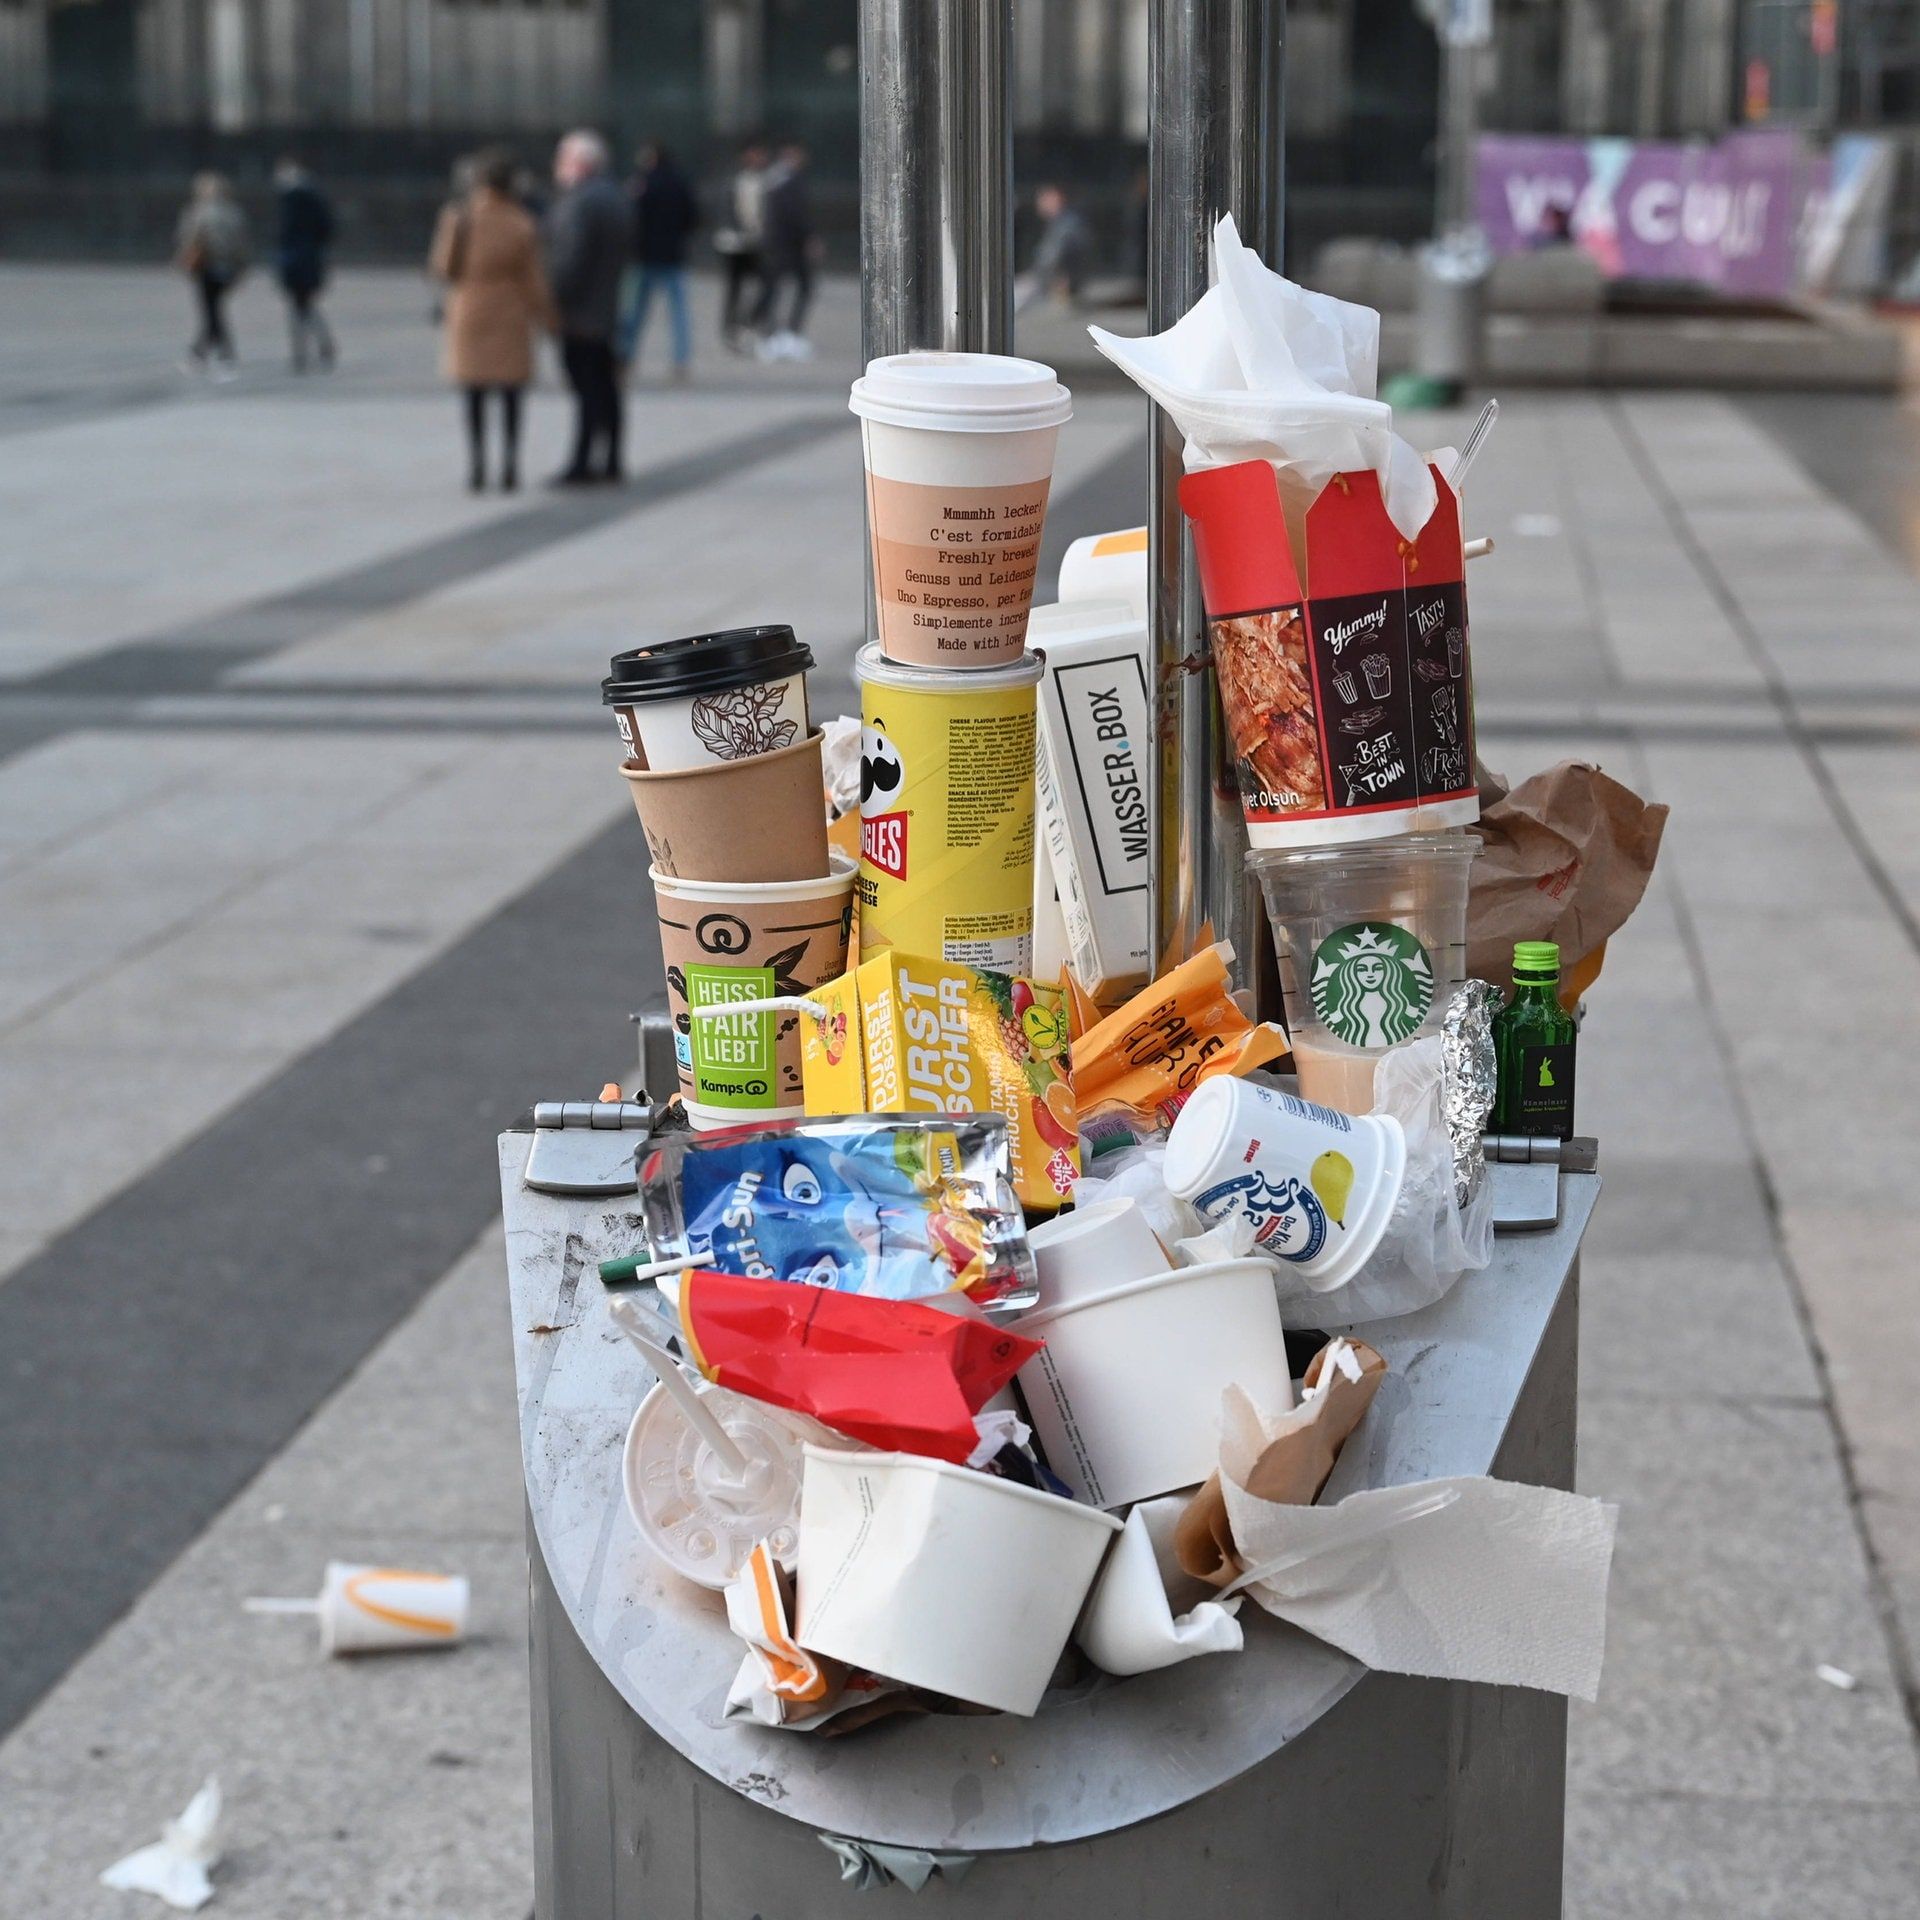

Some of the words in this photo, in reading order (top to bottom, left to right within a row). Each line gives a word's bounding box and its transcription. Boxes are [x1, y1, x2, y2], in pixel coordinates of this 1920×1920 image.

[943, 507, 995, 520] Mmmmhh
[1003, 499, 1043, 519] lecker!
[930, 529, 973, 543] C'est
[938, 551, 995, 565] Freshly
[905, 569, 951, 586] Genuss
[958, 573, 982, 586] und
[897, 588, 917, 604] Uno
[997, 592, 1016, 608] per
[913, 613, 993, 630] Simplemente
[1324, 600, 1387, 655] Yummy!
[937, 637, 967, 651] Made
[973, 637, 1000, 650] with
[862, 819, 902, 870] GLES
[859, 876, 879, 894] EESY
[859, 888, 878, 908] EESE
[699, 981, 758, 1004] HEISS
[701, 1012, 758, 1037] FAIR
[703, 1038, 759, 1063] LIEBT
[899, 968, 946, 1113] URST
[939, 977, 974, 1113] SCHER
[701, 1079, 744, 1096] Kamps
[1243, 1138, 1261, 1164] Birne
[1279, 1214, 1297, 1234] Der
